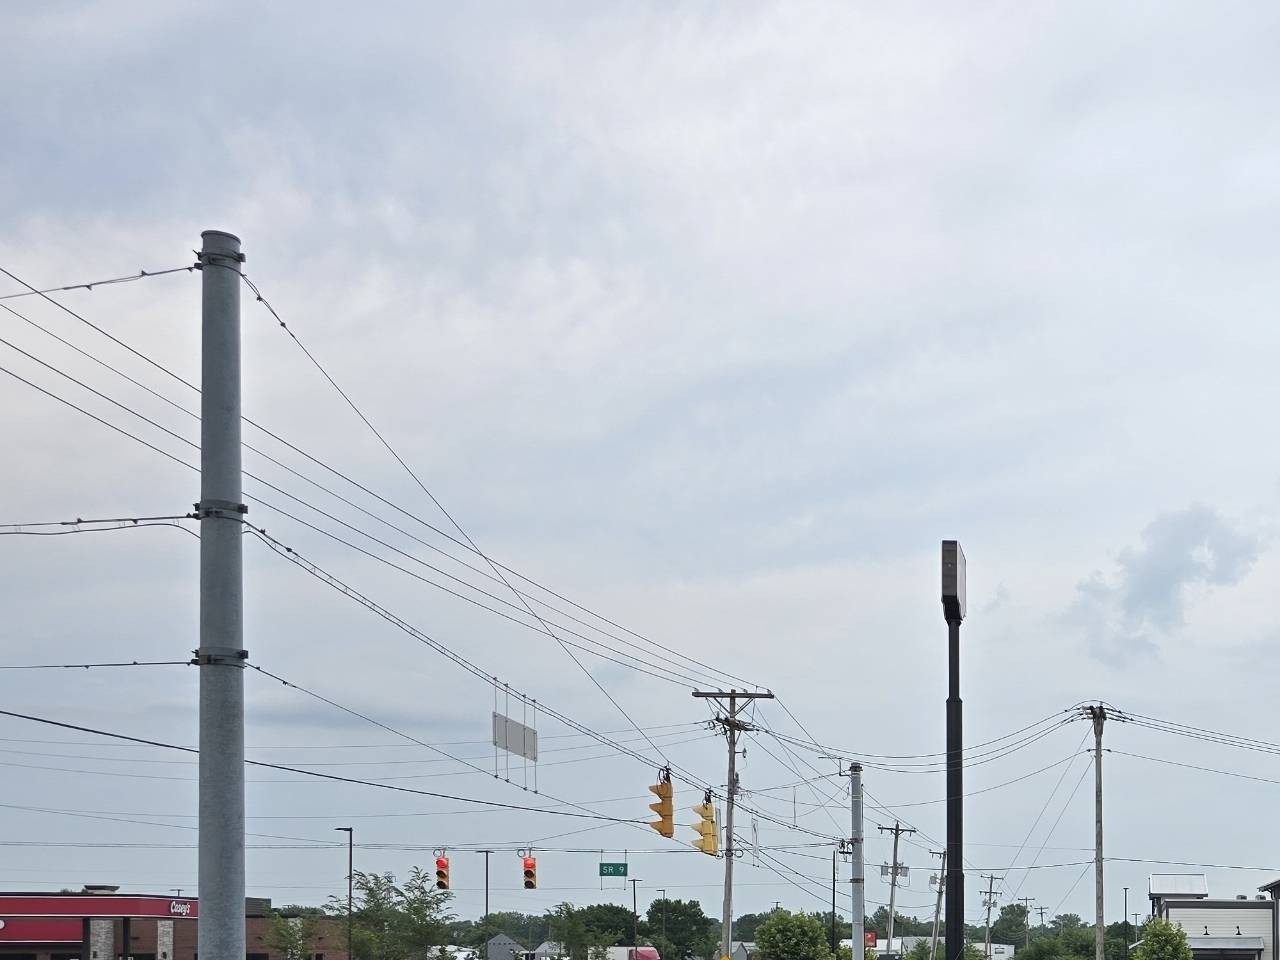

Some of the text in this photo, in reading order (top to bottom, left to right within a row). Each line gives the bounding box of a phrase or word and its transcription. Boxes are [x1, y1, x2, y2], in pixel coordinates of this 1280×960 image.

[602, 866, 625, 874] SR 9
[170, 900, 191, 916] Casey's
